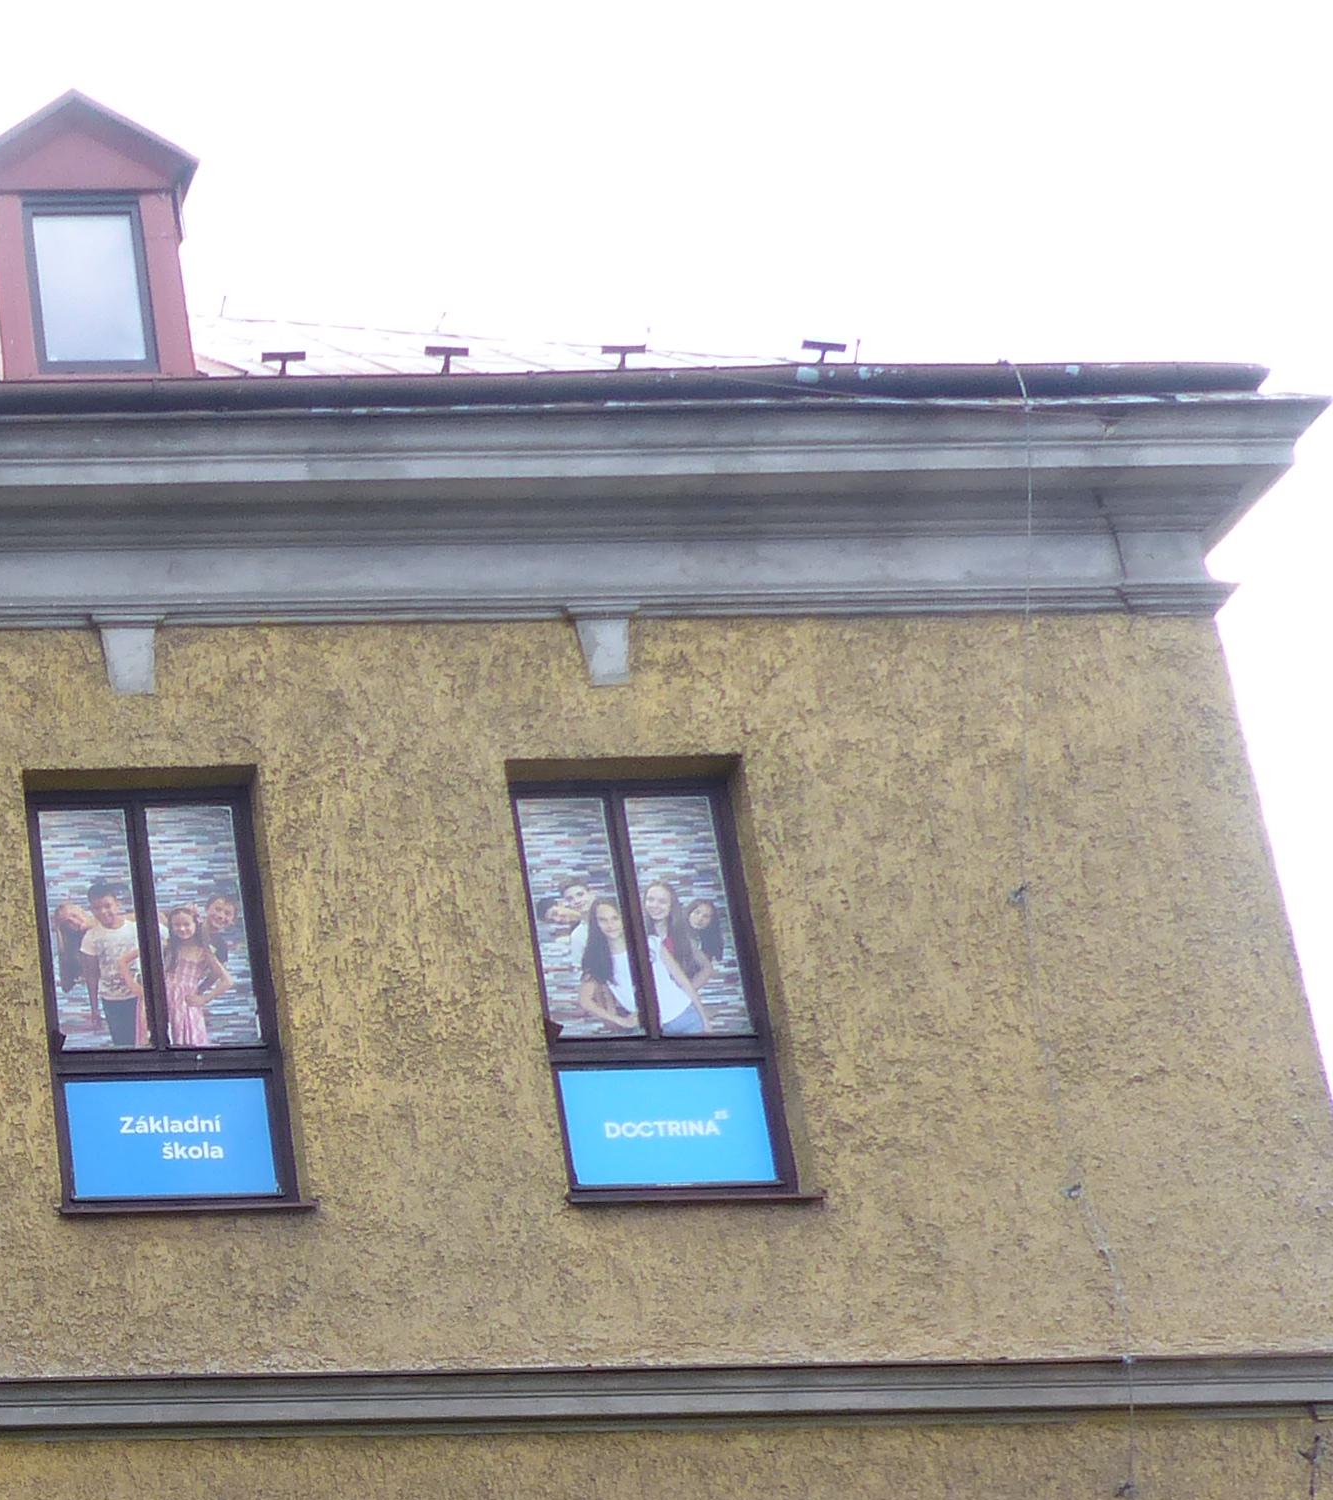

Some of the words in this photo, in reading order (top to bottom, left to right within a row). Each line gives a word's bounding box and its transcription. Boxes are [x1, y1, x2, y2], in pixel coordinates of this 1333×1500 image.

[119, 1114, 222, 1134] Základní
[604, 1118, 721, 1138] DOCTRINA
[162, 1141, 224, 1160] škola
